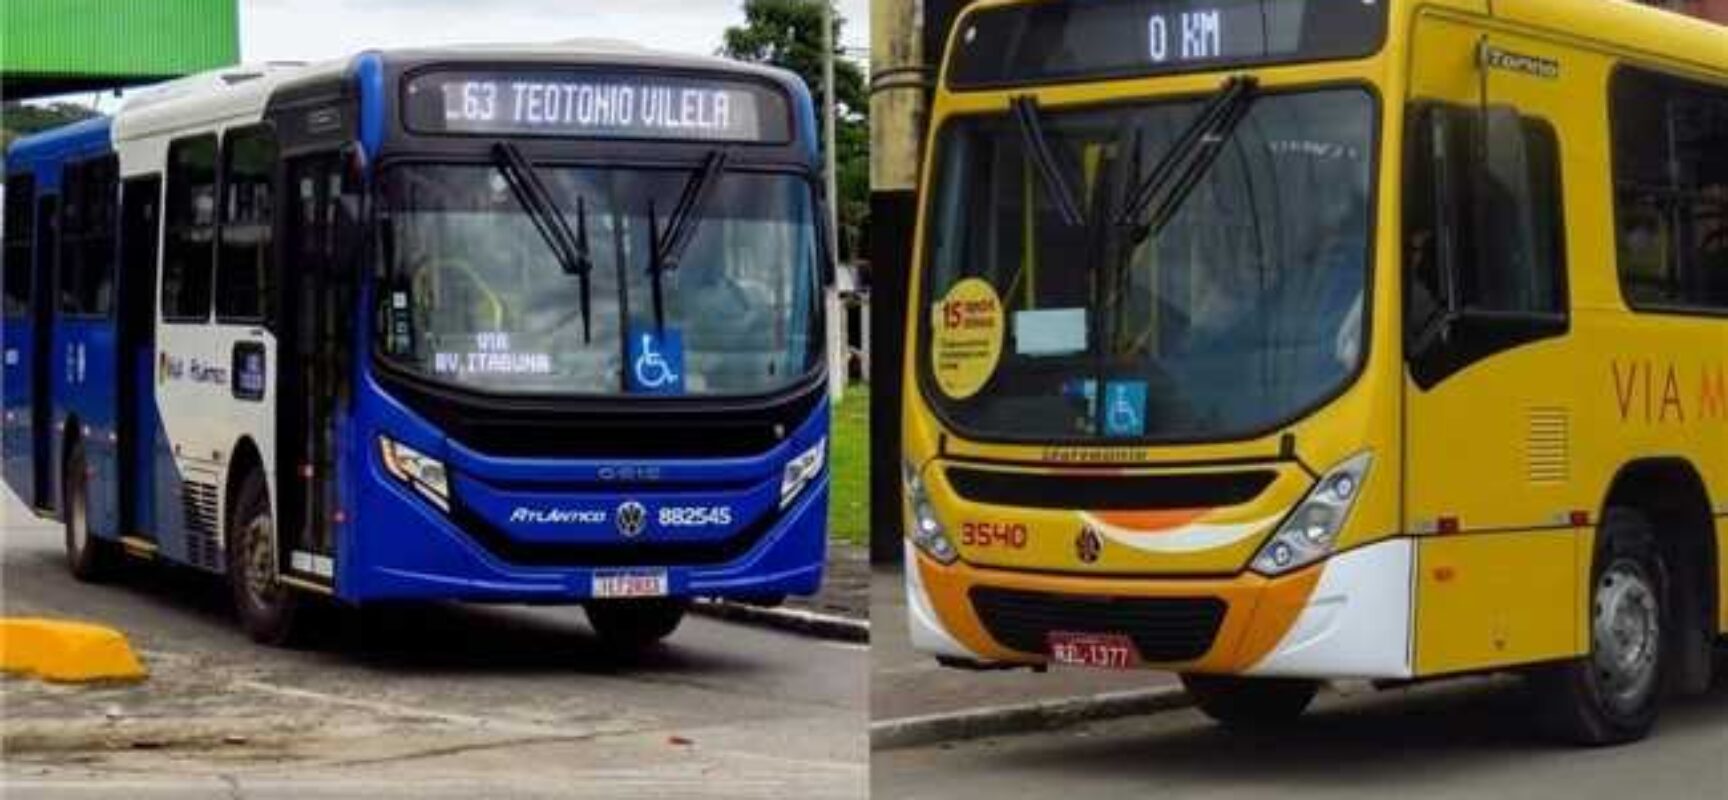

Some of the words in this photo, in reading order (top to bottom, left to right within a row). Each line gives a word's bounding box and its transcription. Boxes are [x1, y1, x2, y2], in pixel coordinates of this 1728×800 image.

[1149, 16, 1165, 62] 0
[1181, 11, 1220, 58] KM
[512, 83, 633, 126] TEOTONIO
[640, 87, 730, 129] VILELA
[943, 301, 961, 330] 15
[477, 331, 510, 352] VIA
[1610, 358, 1685, 426] VIA
[658, 506, 733, 526] 882545
[961, 522, 1028, 550] 3540
